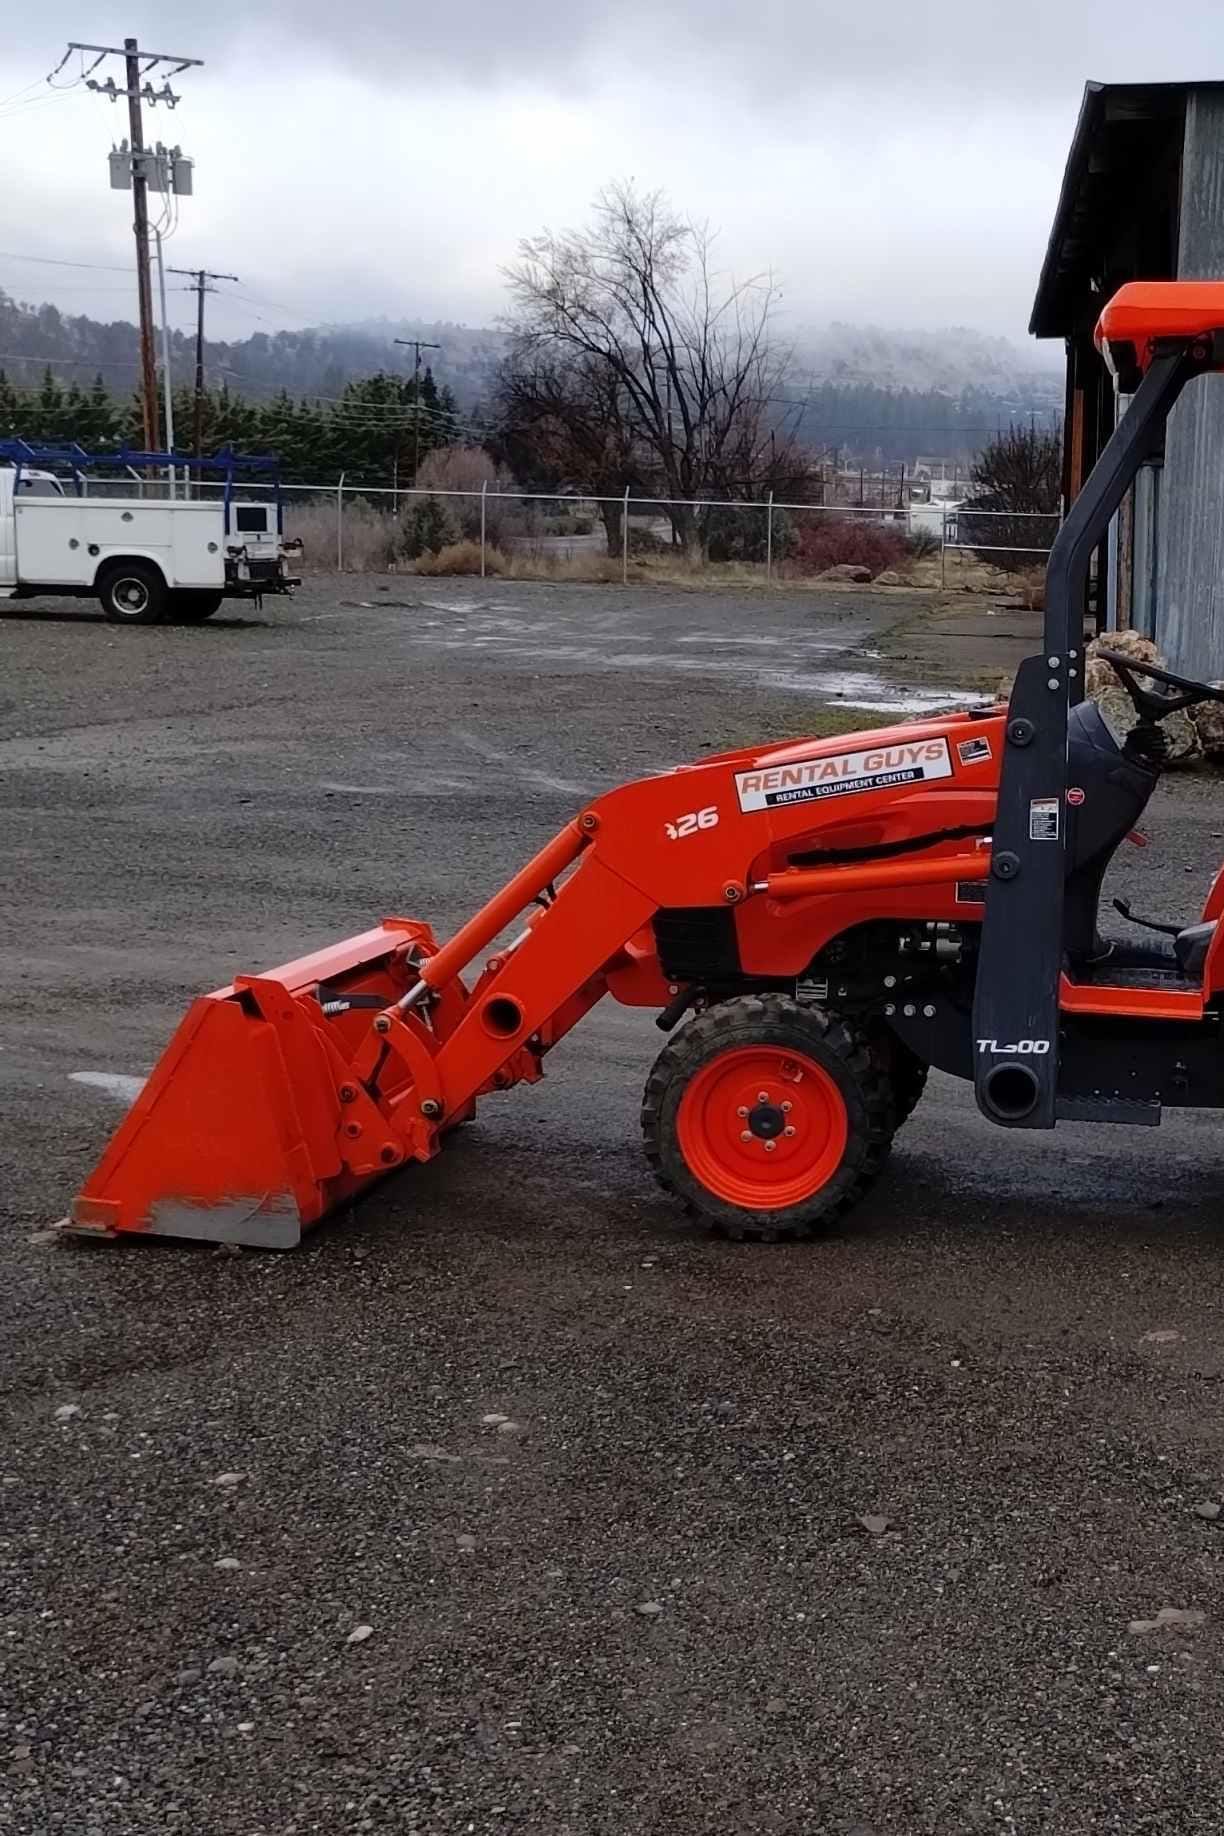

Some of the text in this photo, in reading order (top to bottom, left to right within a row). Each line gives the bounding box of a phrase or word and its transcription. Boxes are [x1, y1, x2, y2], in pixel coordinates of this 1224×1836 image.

[741, 761, 860, 795] RENTAL
[862, 741, 945, 772] GUYS
[775, 770, 915, 803] RENTAL EQUIPMENT CENTER
